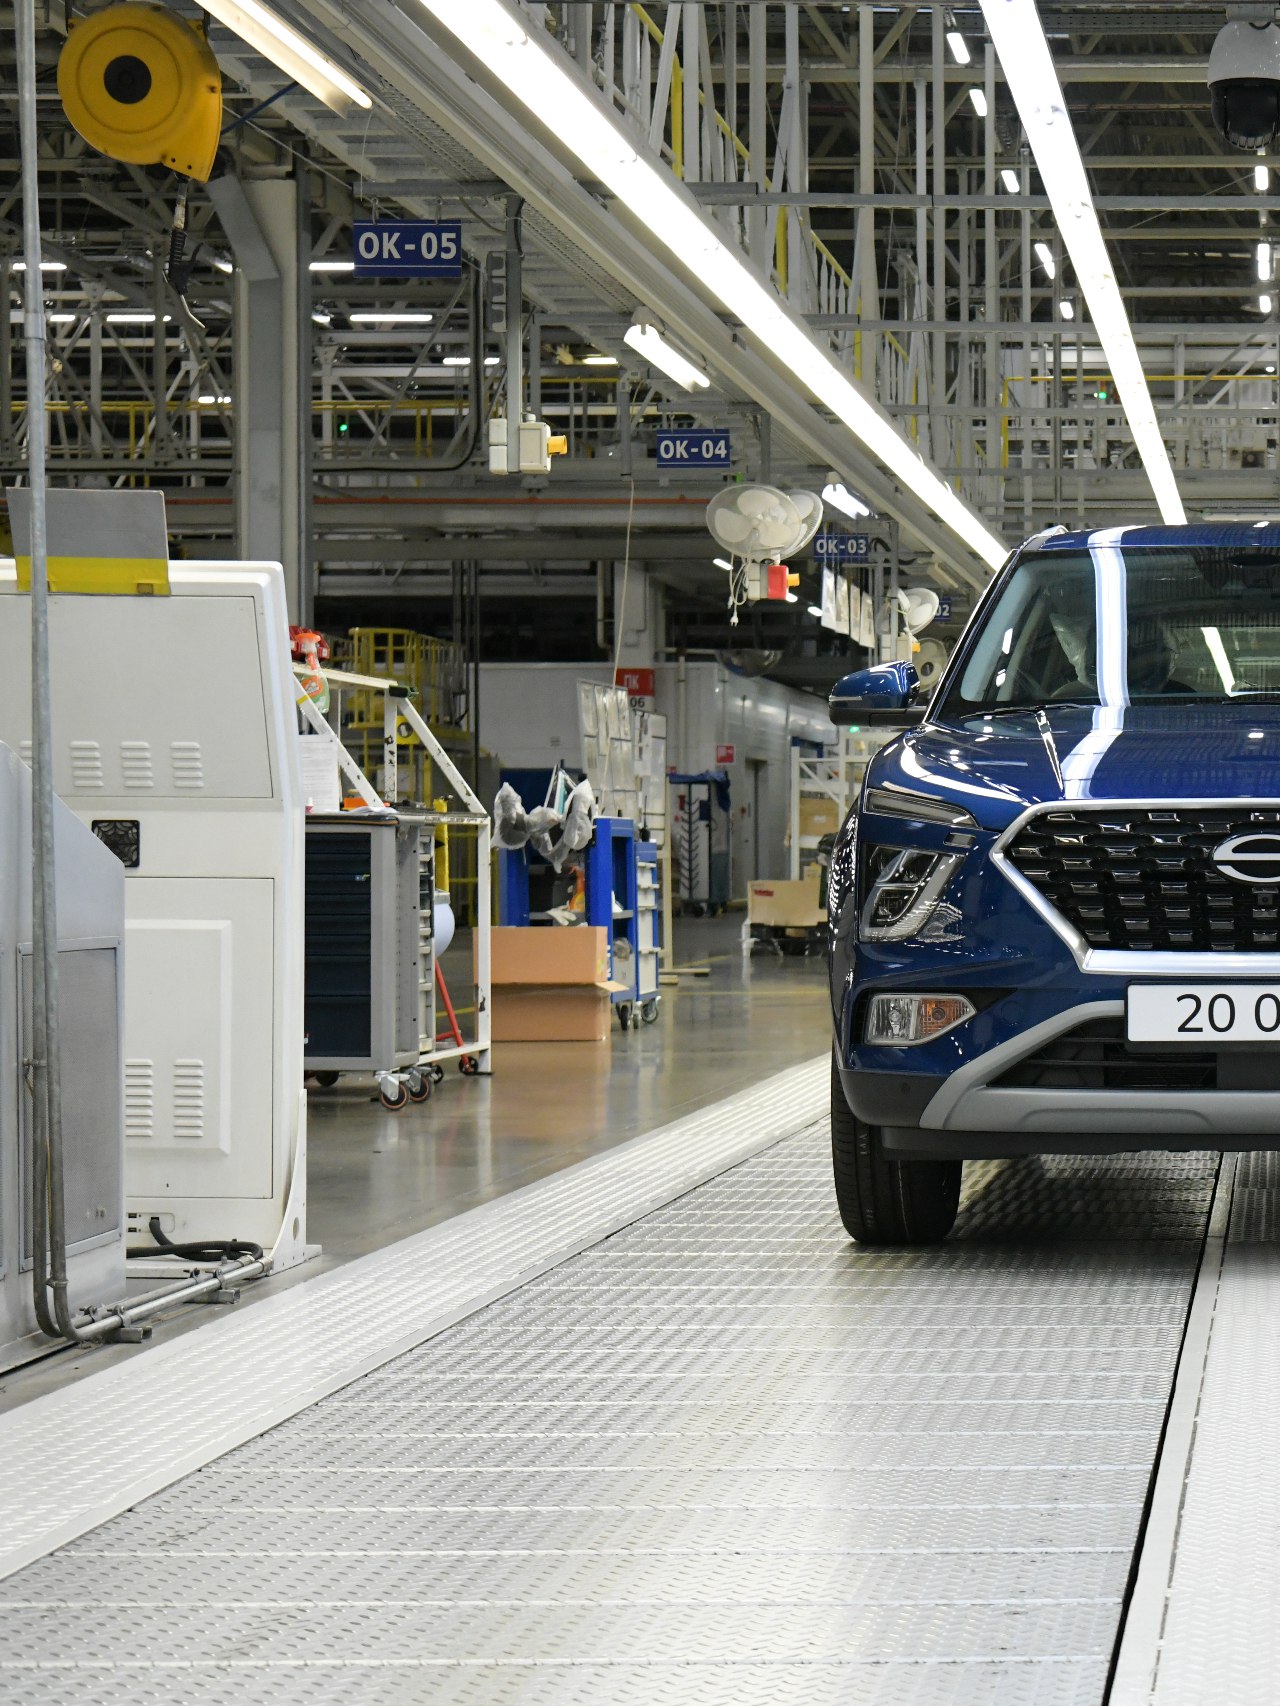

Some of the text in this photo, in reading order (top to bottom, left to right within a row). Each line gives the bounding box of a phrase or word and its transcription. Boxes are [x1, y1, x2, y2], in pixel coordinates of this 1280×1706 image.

[358, 231, 457, 260] OK-05
[660, 439, 727, 459] OK-04
[815, 539, 867, 554] OK-03
[1176, 993, 1235, 1032] 20
